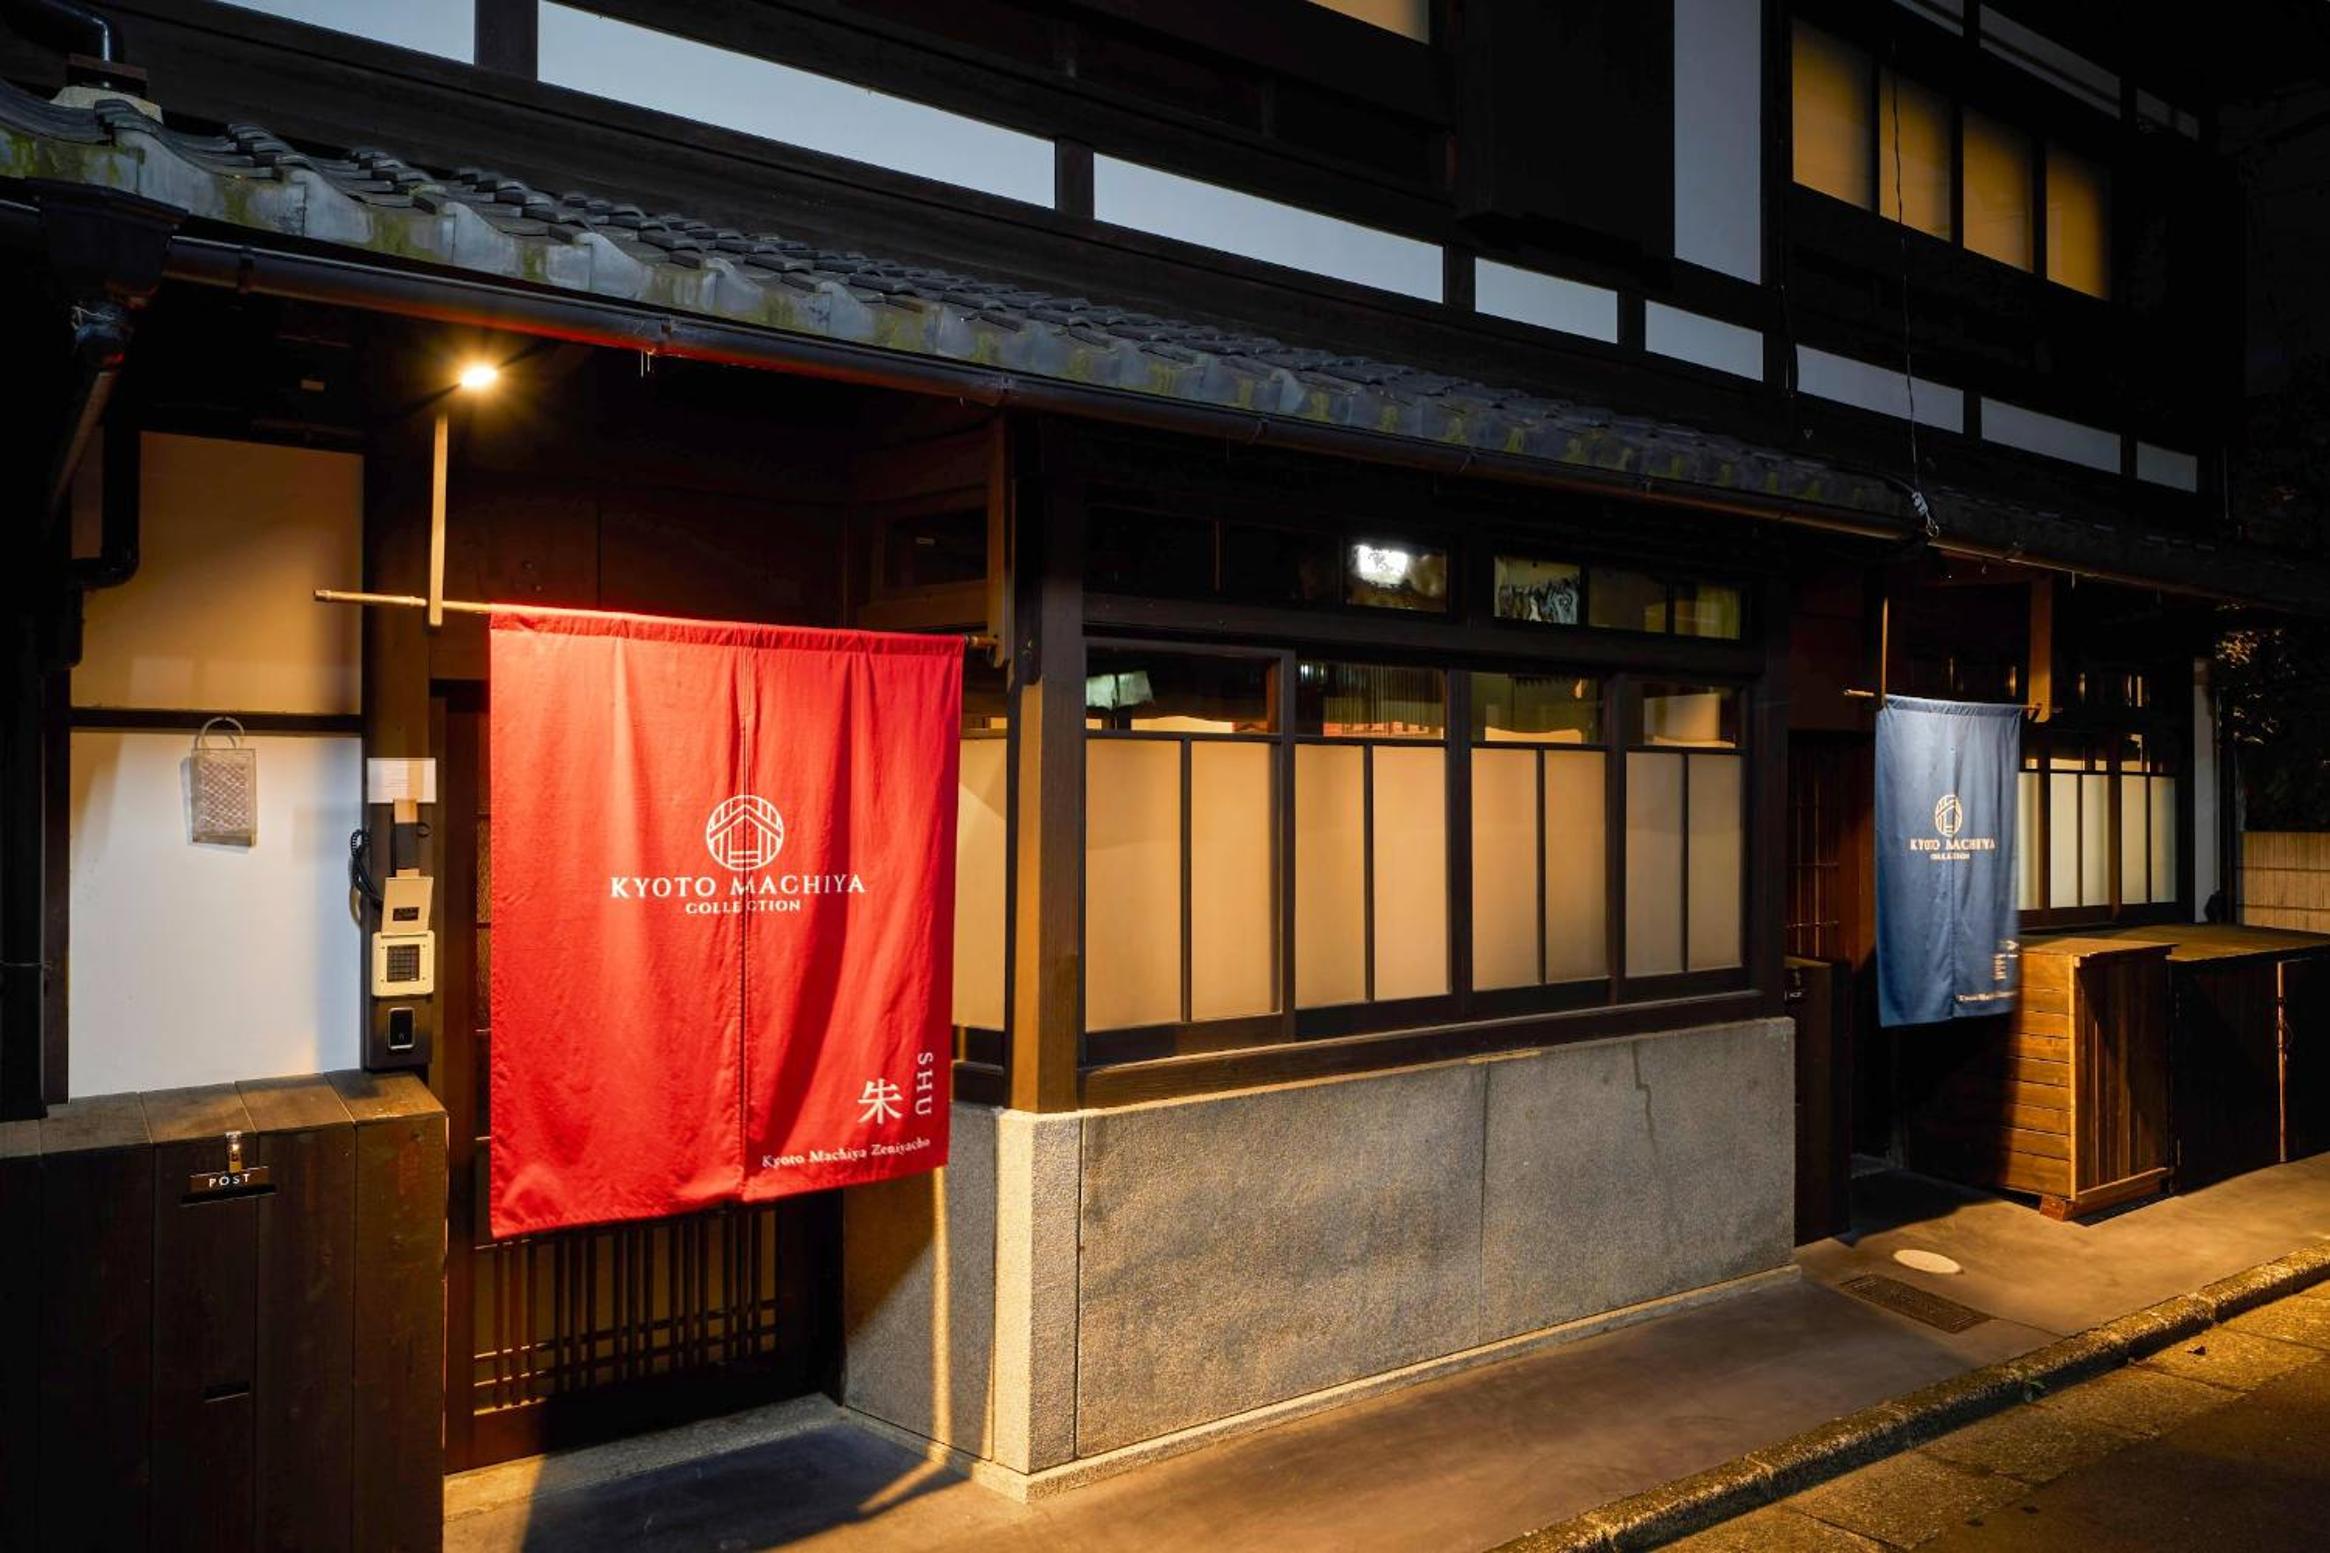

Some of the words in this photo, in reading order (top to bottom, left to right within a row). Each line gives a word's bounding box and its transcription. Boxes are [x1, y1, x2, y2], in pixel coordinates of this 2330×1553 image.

[610, 876, 716, 898] KYOTO
[730, 874, 866, 896] MACHIYA
[686, 900, 801, 914] COLLECTION
[915, 1051, 934, 1116] SHU
[857, 1077, 904, 1125] 朱
[762, 1154, 805, 1169] Kyoto
[808, 1148, 868, 1164] Machiya
[208, 1173, 250, 1188] POST
